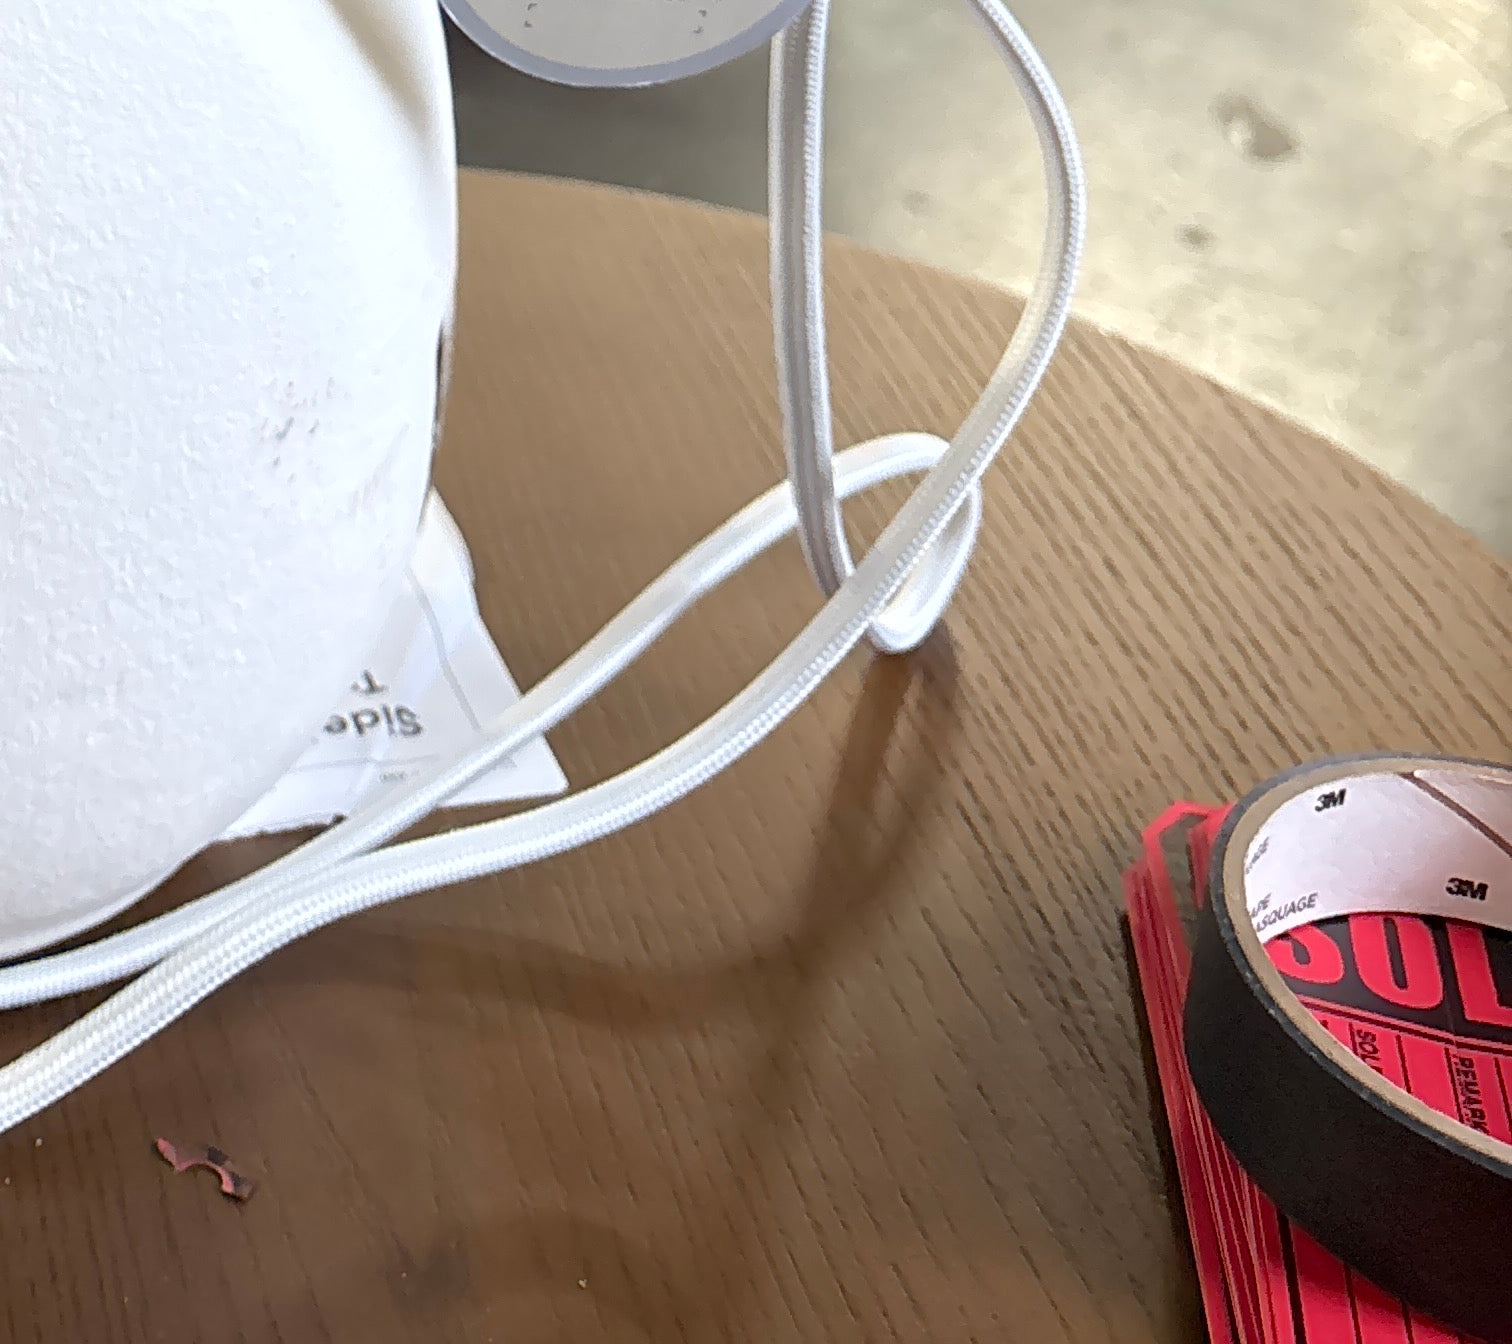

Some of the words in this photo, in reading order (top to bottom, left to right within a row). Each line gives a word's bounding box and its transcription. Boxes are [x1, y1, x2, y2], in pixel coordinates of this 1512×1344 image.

[323, 704, 423, 738] Side
[1314, 787, 1348, 813] 3M
[1445, 877, 1489, 902] 3M
